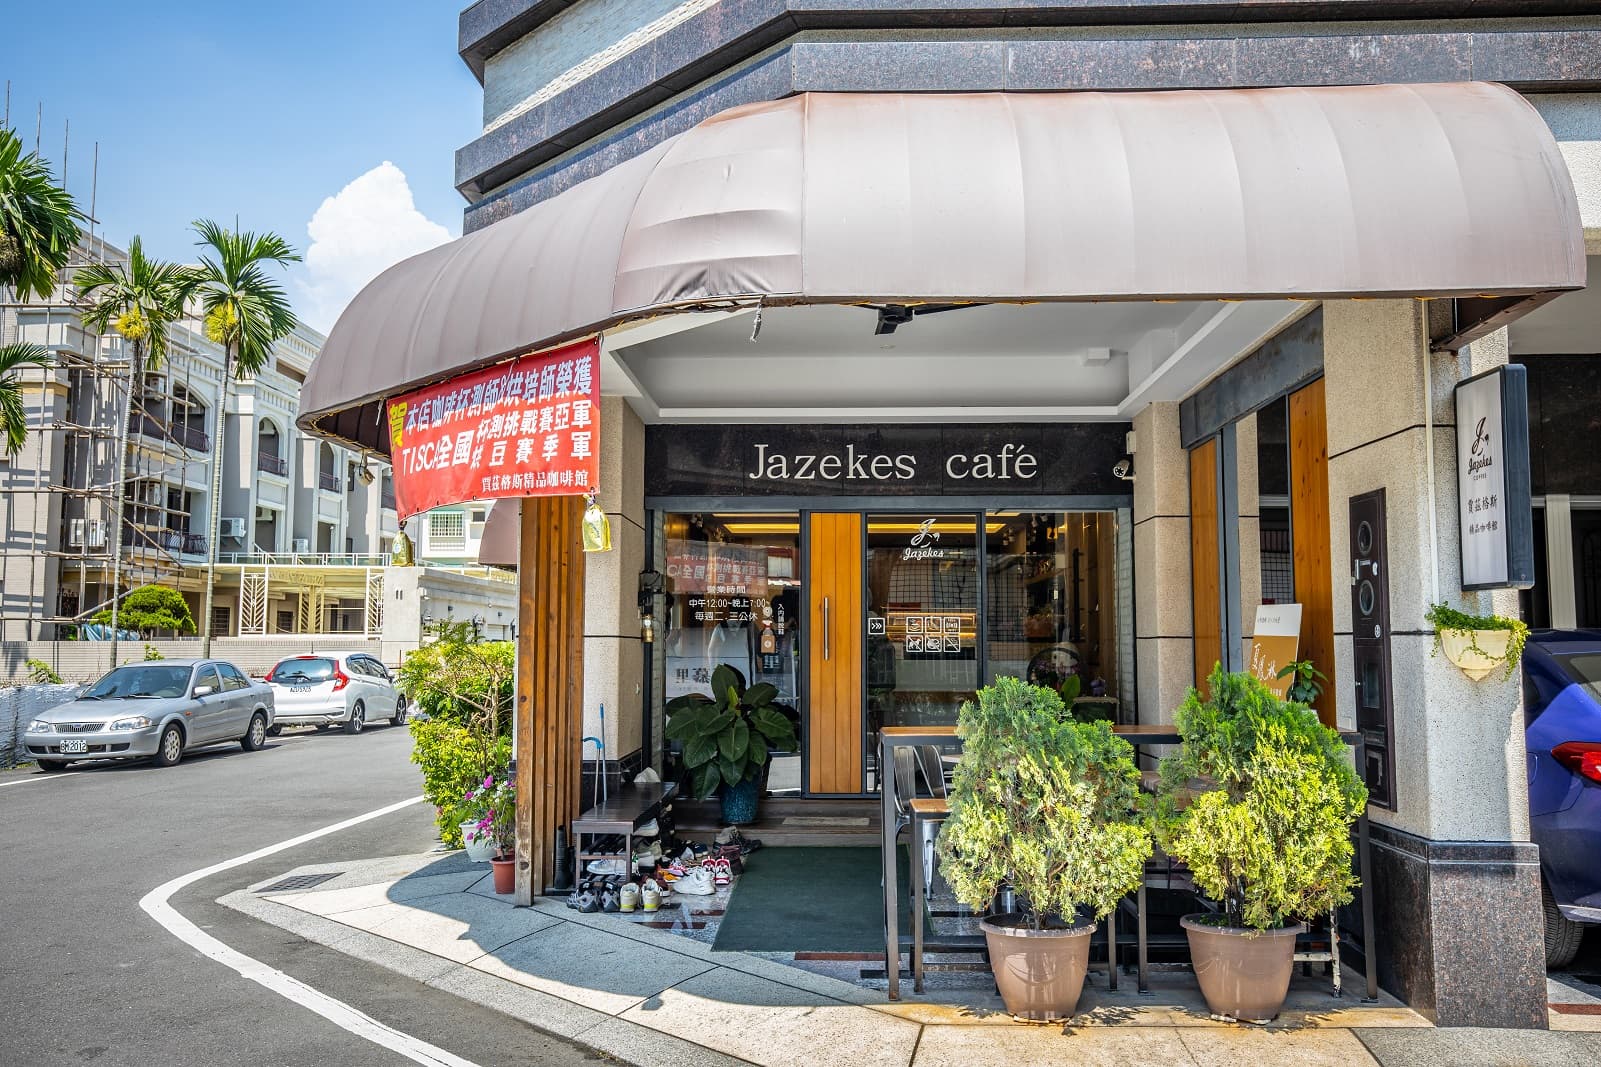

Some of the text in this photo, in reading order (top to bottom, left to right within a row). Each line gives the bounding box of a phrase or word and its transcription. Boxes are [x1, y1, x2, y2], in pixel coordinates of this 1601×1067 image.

[390, 402, 408, 450] 賀
[749, 443, 1038, 480] Jazekes café
[902, 547, 945, 561] Jazekes
